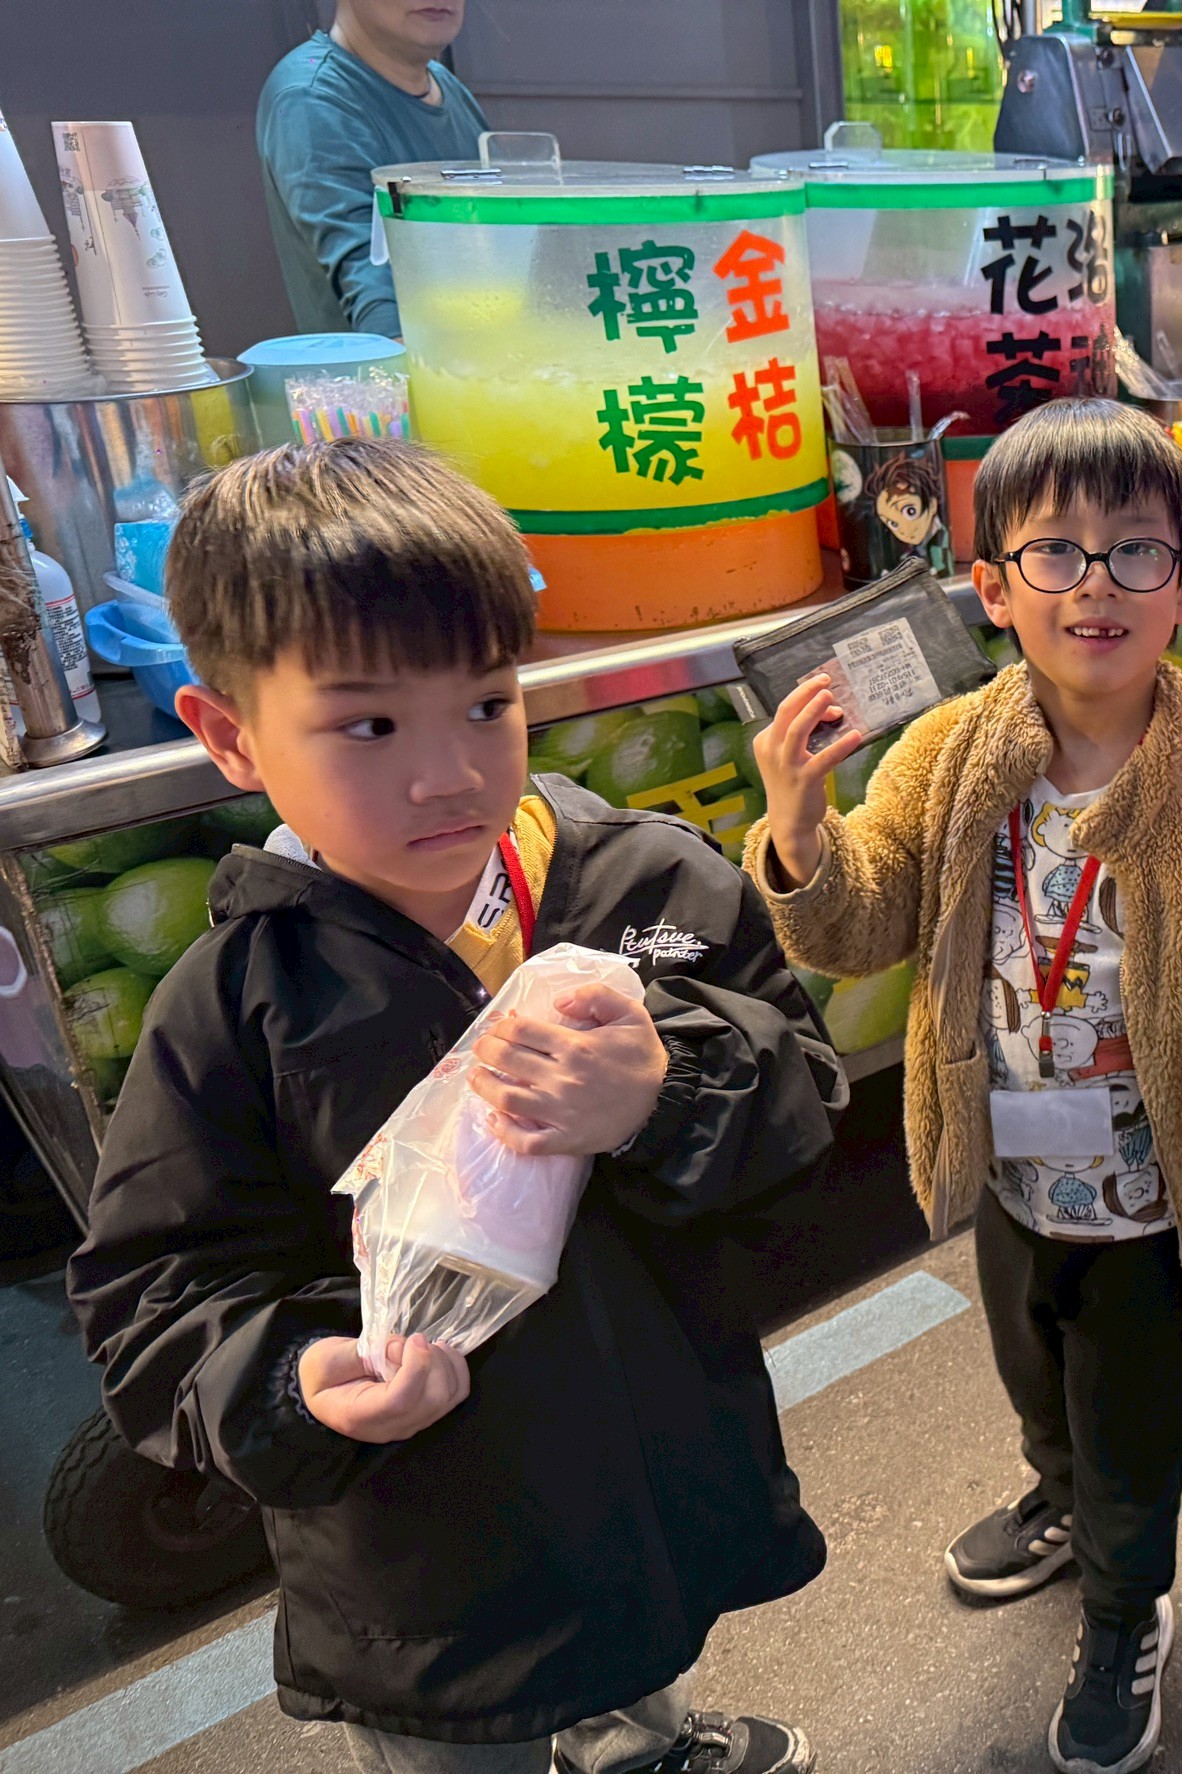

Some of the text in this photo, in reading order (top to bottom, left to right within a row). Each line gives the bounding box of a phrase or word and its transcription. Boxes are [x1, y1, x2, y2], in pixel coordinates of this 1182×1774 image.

[586, 239, 706, 486] 檸檬
[713, 228, 803, 461] 金桔
[980, 213, 1062, 425] 花茶
